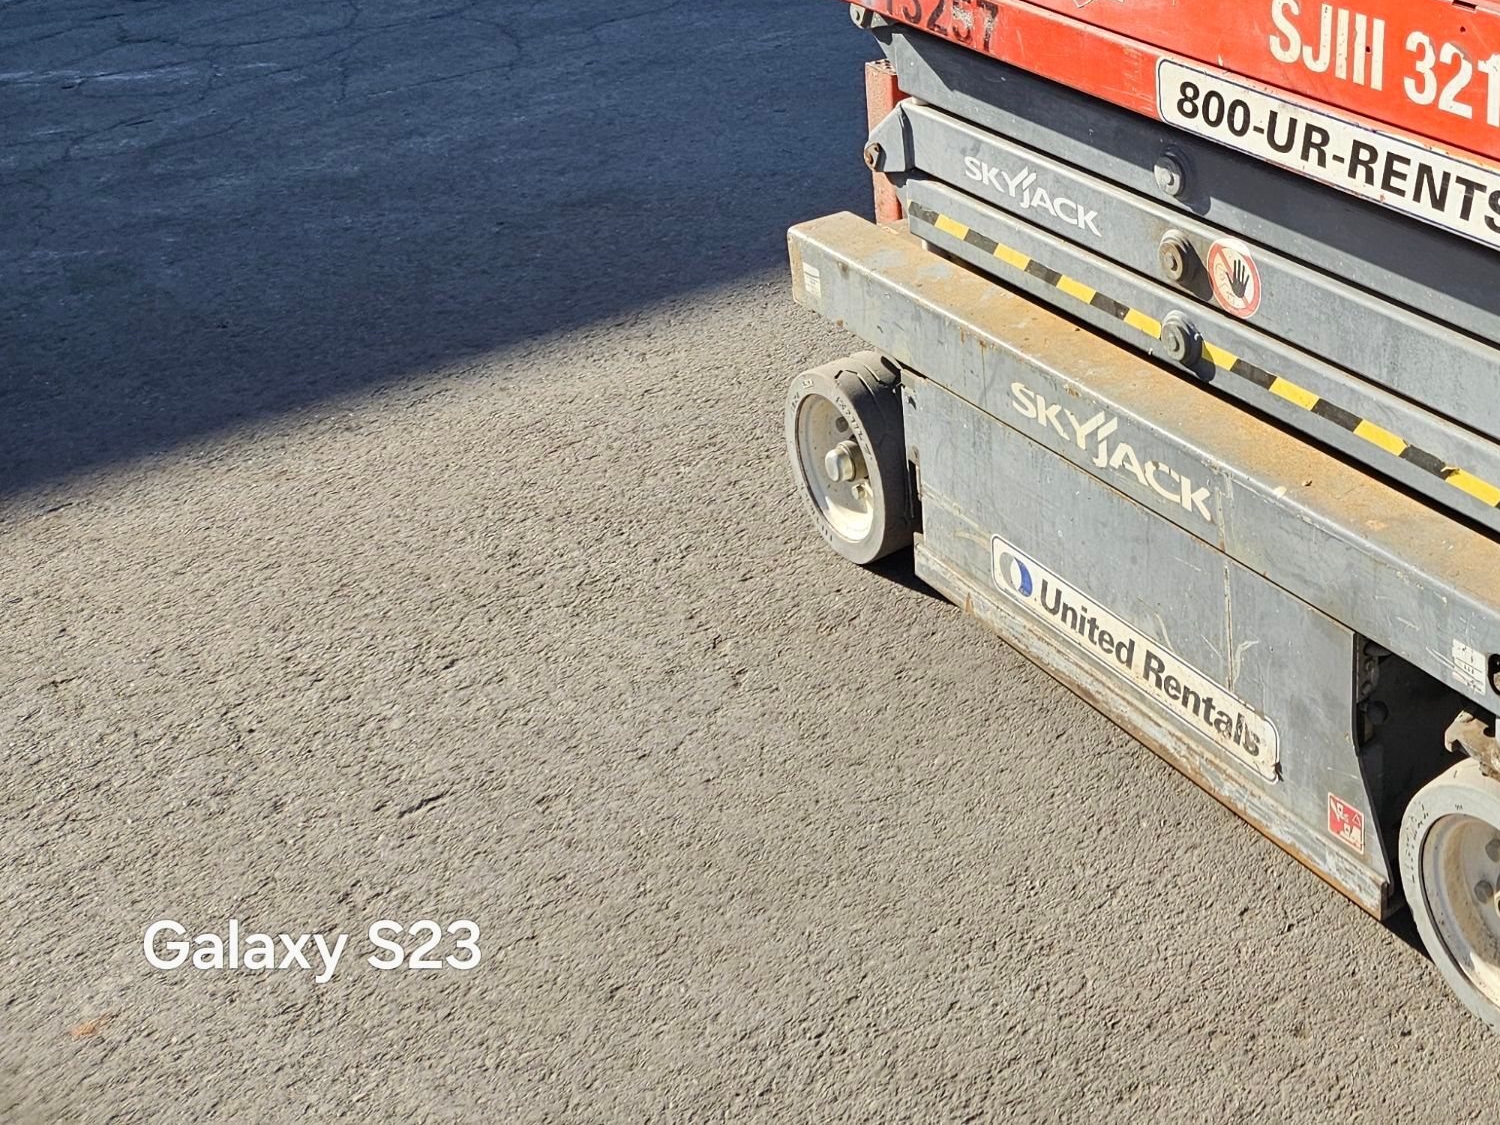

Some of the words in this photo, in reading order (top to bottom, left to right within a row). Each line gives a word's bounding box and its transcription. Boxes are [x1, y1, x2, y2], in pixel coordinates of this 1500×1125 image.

[963, 155, 1103, 238] SKYJACK
[1010, 381, 1215, 523] SKYJACK
[1040, 580, 1136, 671] United
[1142, 649, 1261, 757] Rentals
